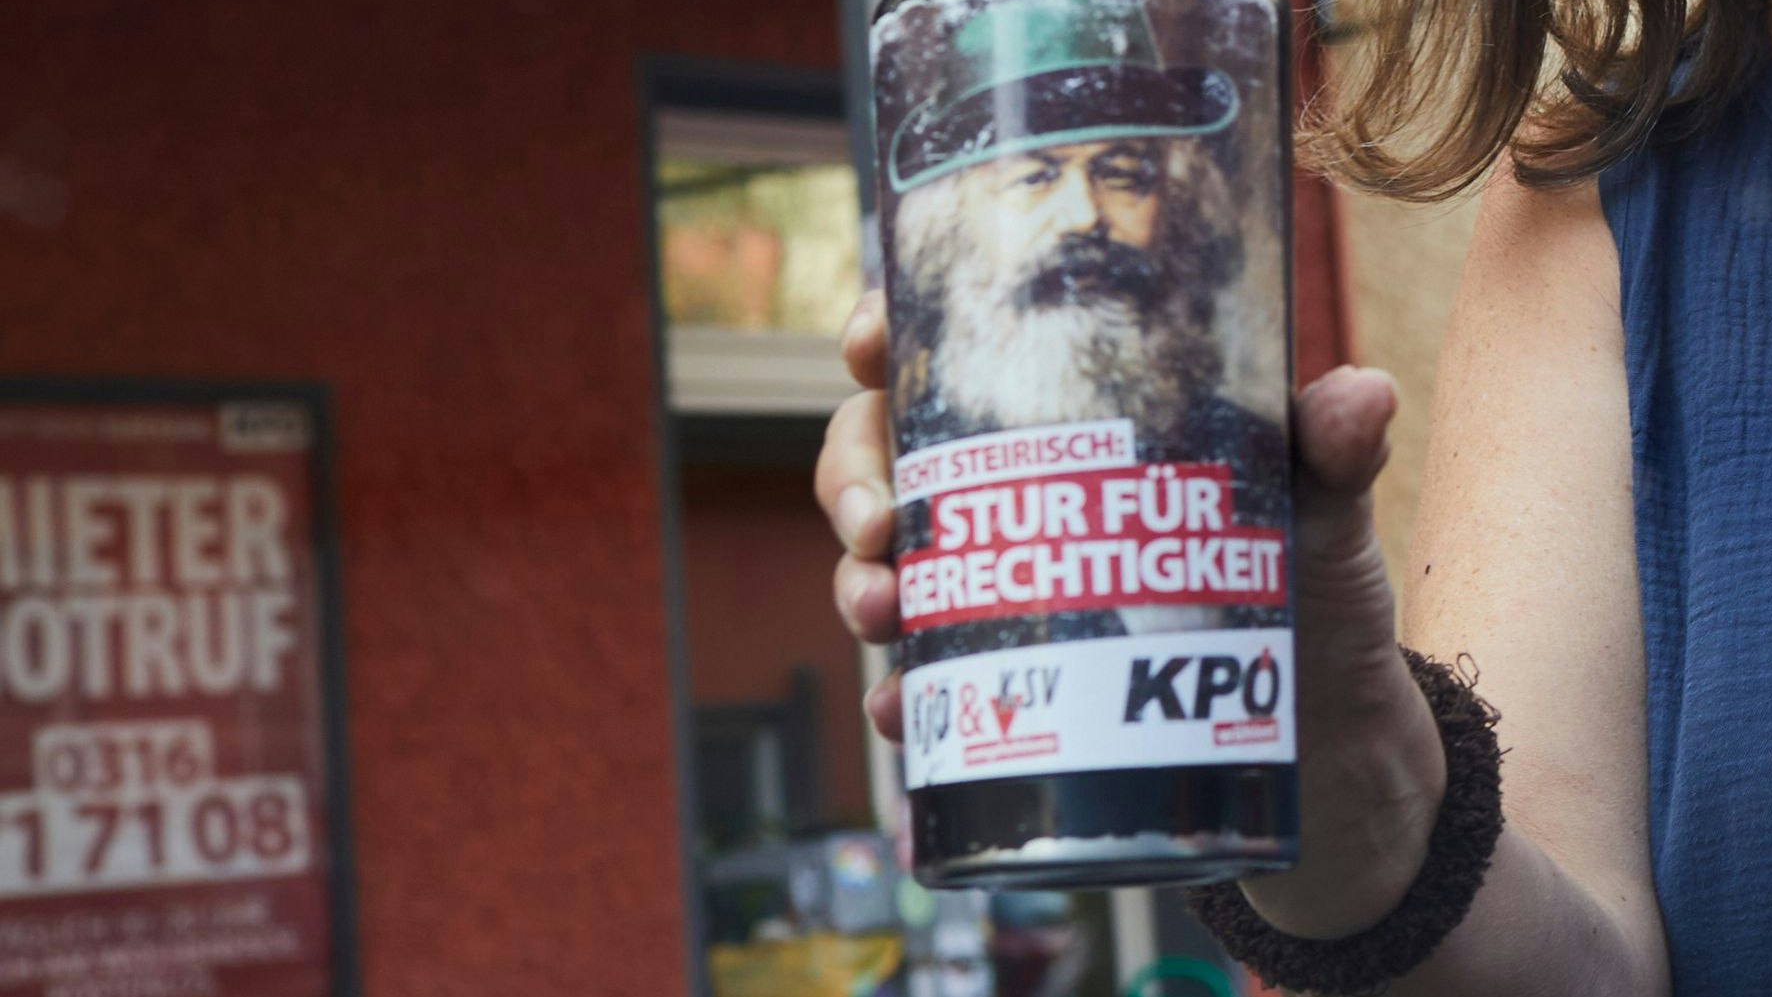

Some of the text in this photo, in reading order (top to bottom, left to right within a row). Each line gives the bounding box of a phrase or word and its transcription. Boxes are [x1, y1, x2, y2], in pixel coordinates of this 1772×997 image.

[950, 430, 1125, 479] STEIRISCH:
[937, 464, 1223, 551] STUR FÜR
[901, 538, 1282, 621] GERECHTIGKEIT
[52, 735, 199, 795] 0316
